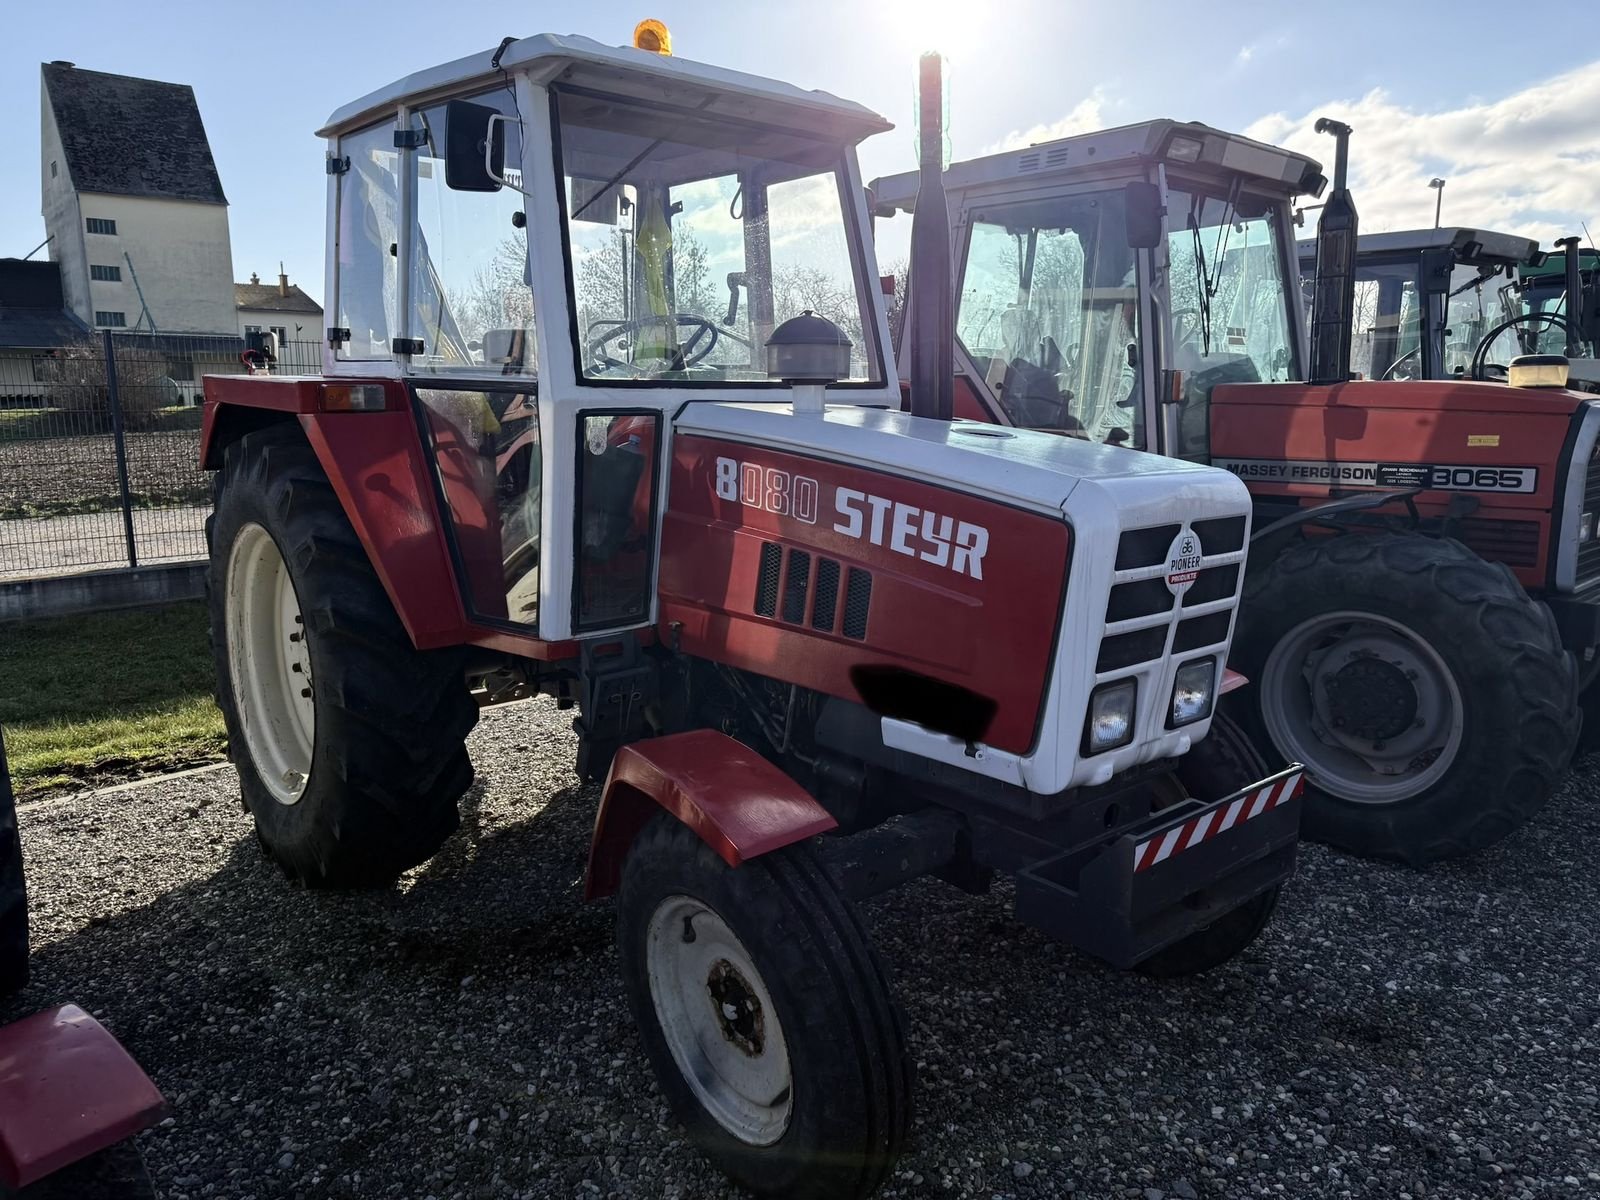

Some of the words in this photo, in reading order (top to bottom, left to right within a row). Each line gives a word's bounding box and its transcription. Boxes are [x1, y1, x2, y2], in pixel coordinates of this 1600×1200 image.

[1226, 463, 1289, 477] MASSEY
[1291, 466, 1376, 480] FERGUSON
[1433, 468, 1523, 489] 3065
[716, 456, 819, 525] 8080
[833, 486, 990, 581] STEYR
[1170, 556, 1201, 571] PIONEER
